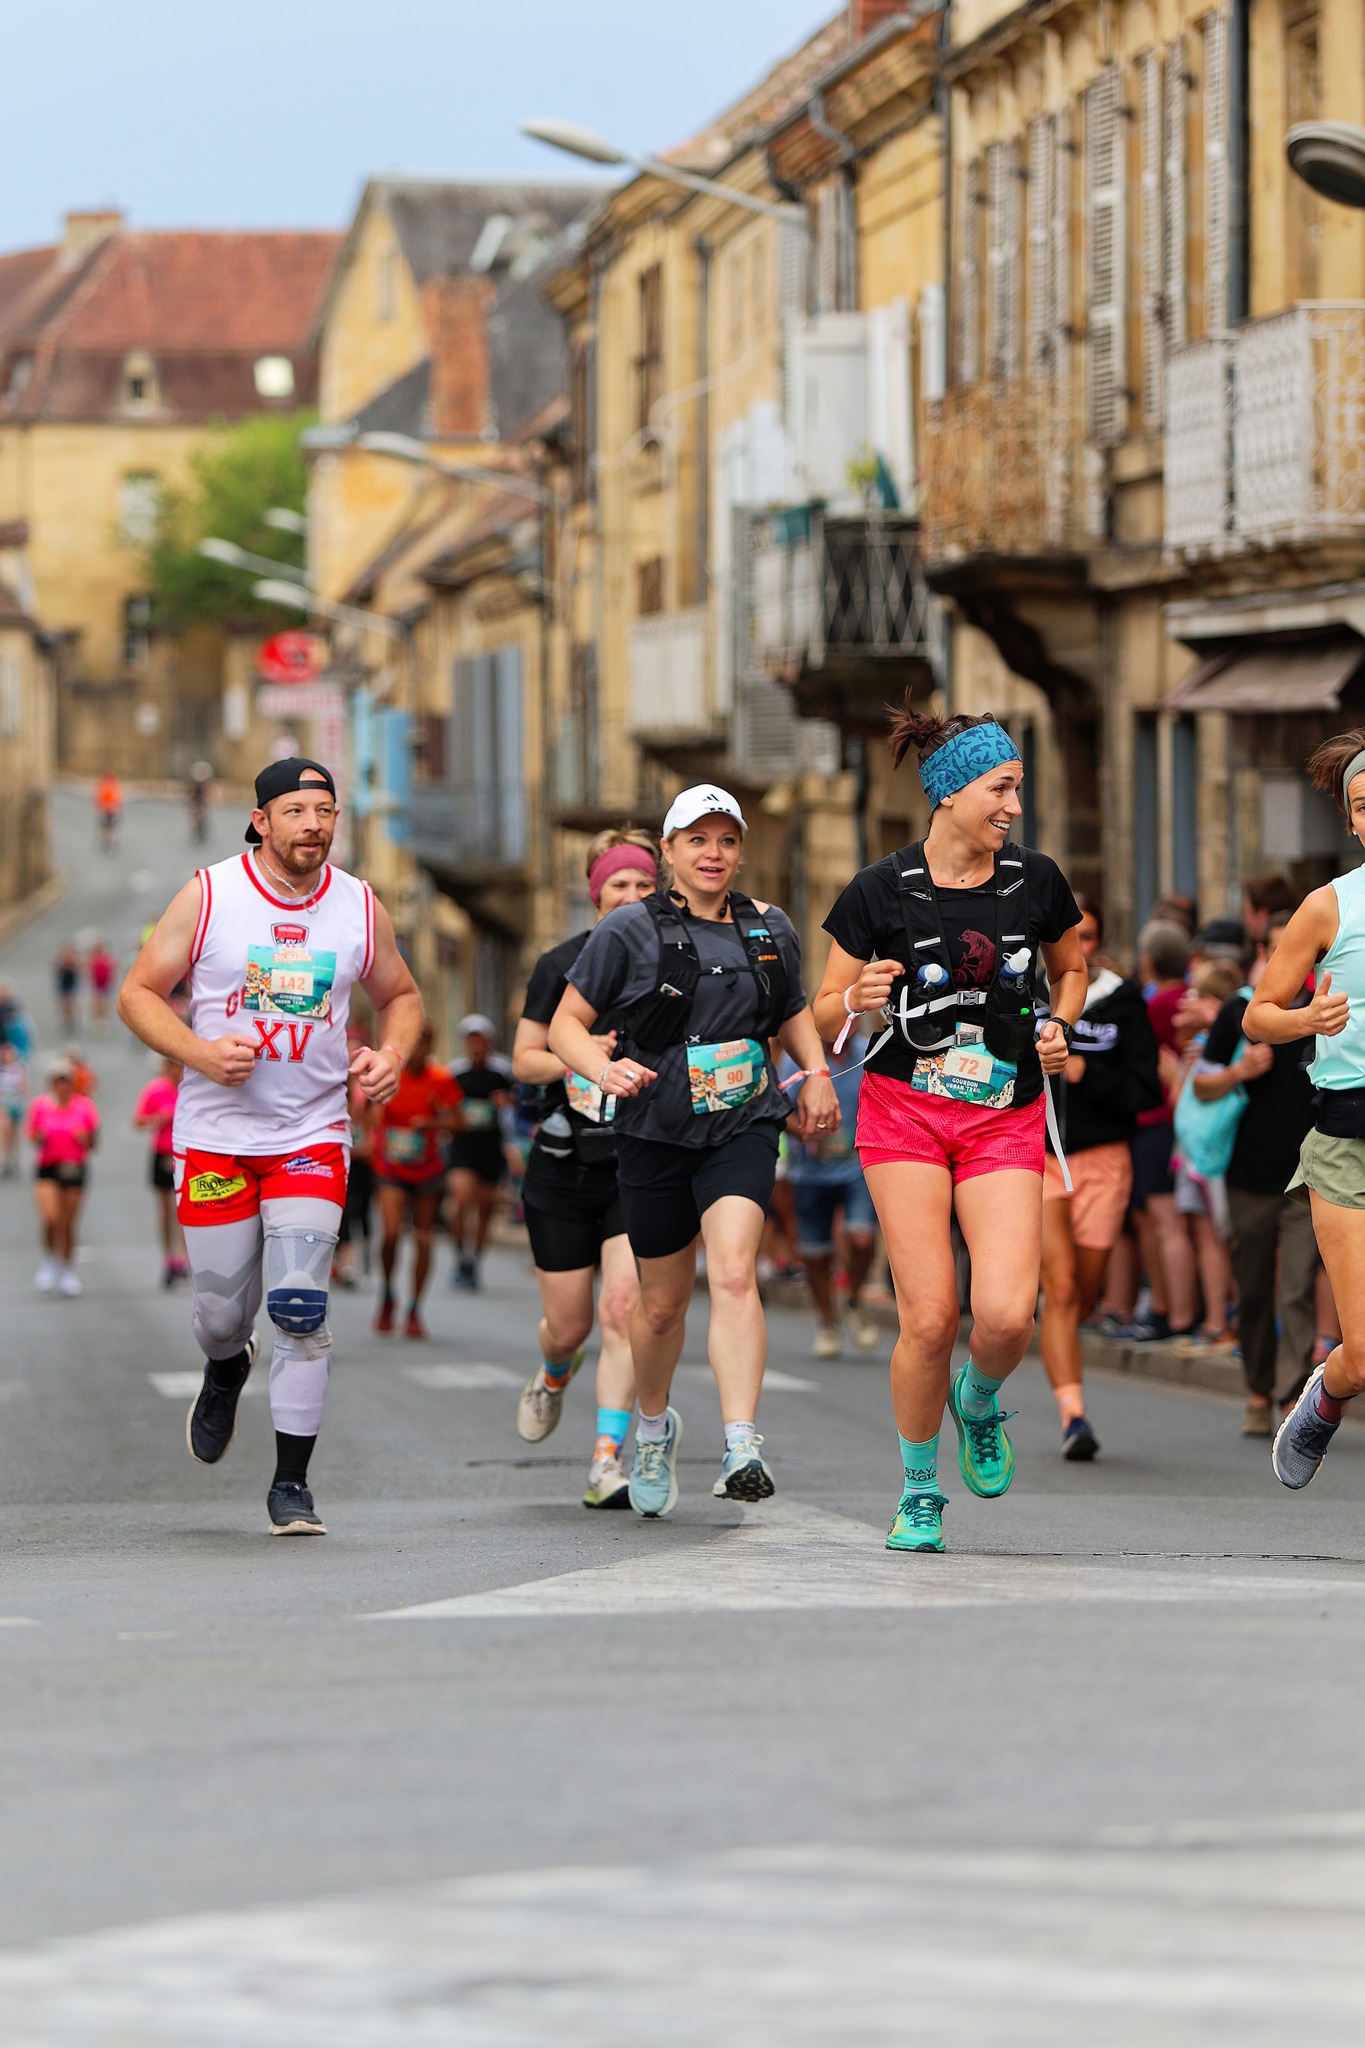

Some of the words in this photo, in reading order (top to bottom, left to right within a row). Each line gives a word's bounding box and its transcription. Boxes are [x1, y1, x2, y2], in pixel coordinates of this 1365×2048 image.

[280, 975, 305, 991] 142
[253, 1017, 314, 1063] XV
[958, 1057, 980, 1076] 72
[727, 1070, 744, 1085] 90
[952, 1077, 978, 1087] GOURDON
[945, 1083, 965, 1091] URBAN
[966, 1086, 981, 1094] TRAIL
[194, 1193, 243, 1208] MACONNERIE
[905, 1466, 932, 1476] STAY
